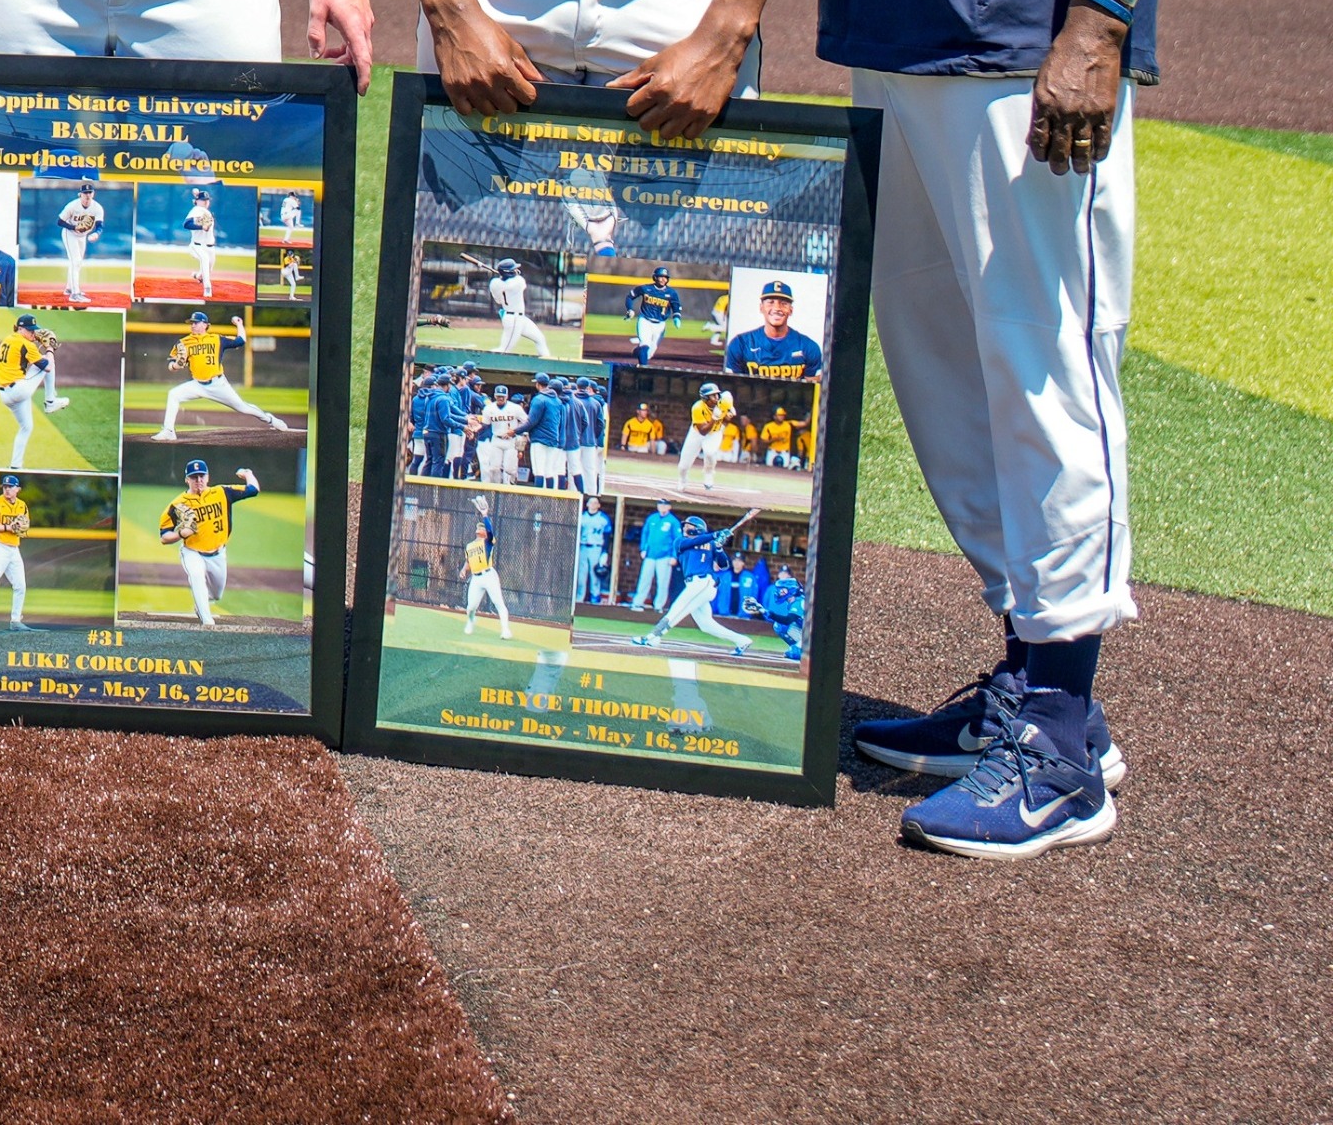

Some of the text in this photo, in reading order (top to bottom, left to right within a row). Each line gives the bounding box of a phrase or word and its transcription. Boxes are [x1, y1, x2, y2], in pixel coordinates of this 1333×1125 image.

[68, 95, 130, 112] State
[139, 96, 268, 121] University
[53, 122, 189, 142] BASEBALL
[481, 115, 786, 160] Coppin State University
[113, 152, 255, 174] Conference
[558, 151, 702, 179] BASEBALL
[490, 175, 768, 214] Northeast Conference
[0, 343, 10, 364] 31
[188, 344, 215, 356] COPPIN
[206, 355, 216, 365] 31
[87, 630, 124, 647] #31
[7, 651, 204, 676] LUKE CORCORAN
[40, 678, 81, 698] Day
[103, 681, 147, 702] May
[159, 683, 190, 703] 16,
[196, 686, 250, 704] 2026
[580, 673, 604, 690] #1
[480, 687, 704, 727] BRYCE THOMPSON
[441, 709, 740, 757] Senior Day May 16, 2026
